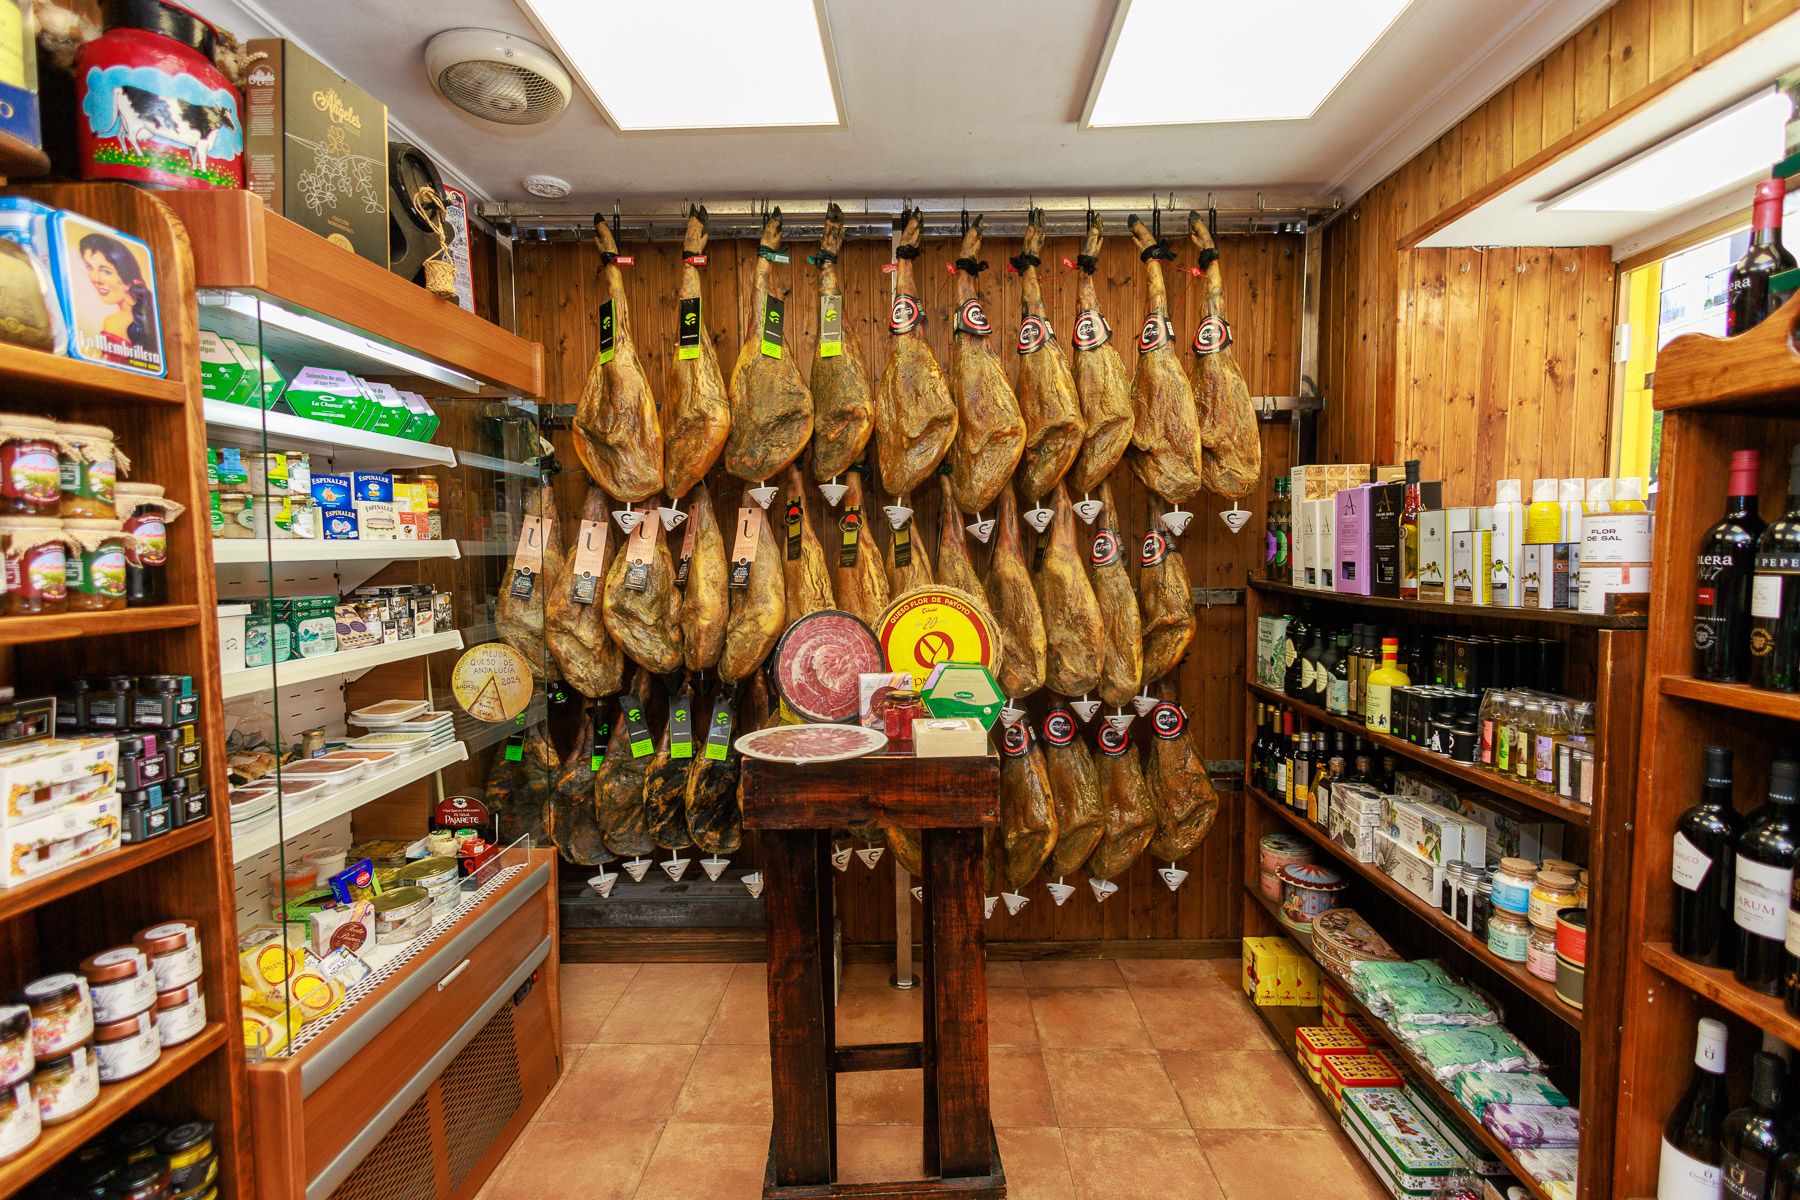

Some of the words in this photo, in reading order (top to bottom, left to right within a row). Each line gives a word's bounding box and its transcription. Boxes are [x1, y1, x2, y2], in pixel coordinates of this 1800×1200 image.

[311, 477, 348, 488] ESPINALER
[358, 475, 389, 484] ESPINALER
[365, 504, 394, 513] ESPINALER
[325, 509, 356, 519] ESPINALER
[1762, 558, 1800, 567] PEPE
[890, 604, 910, 624] QUESO
[910, 597, 929, 609] FLOR
[931, 596, 942, 604] DE
[944, 597, 971, 616] PAYOYO
[482, 650, 508, 658] MEJOR
[470, 659, 496, 667] QUESO
[504, 659, 514, 667] DE
[501, 676, 521, 686] 2024
[444, 814, 480, 826] PAJARETE
